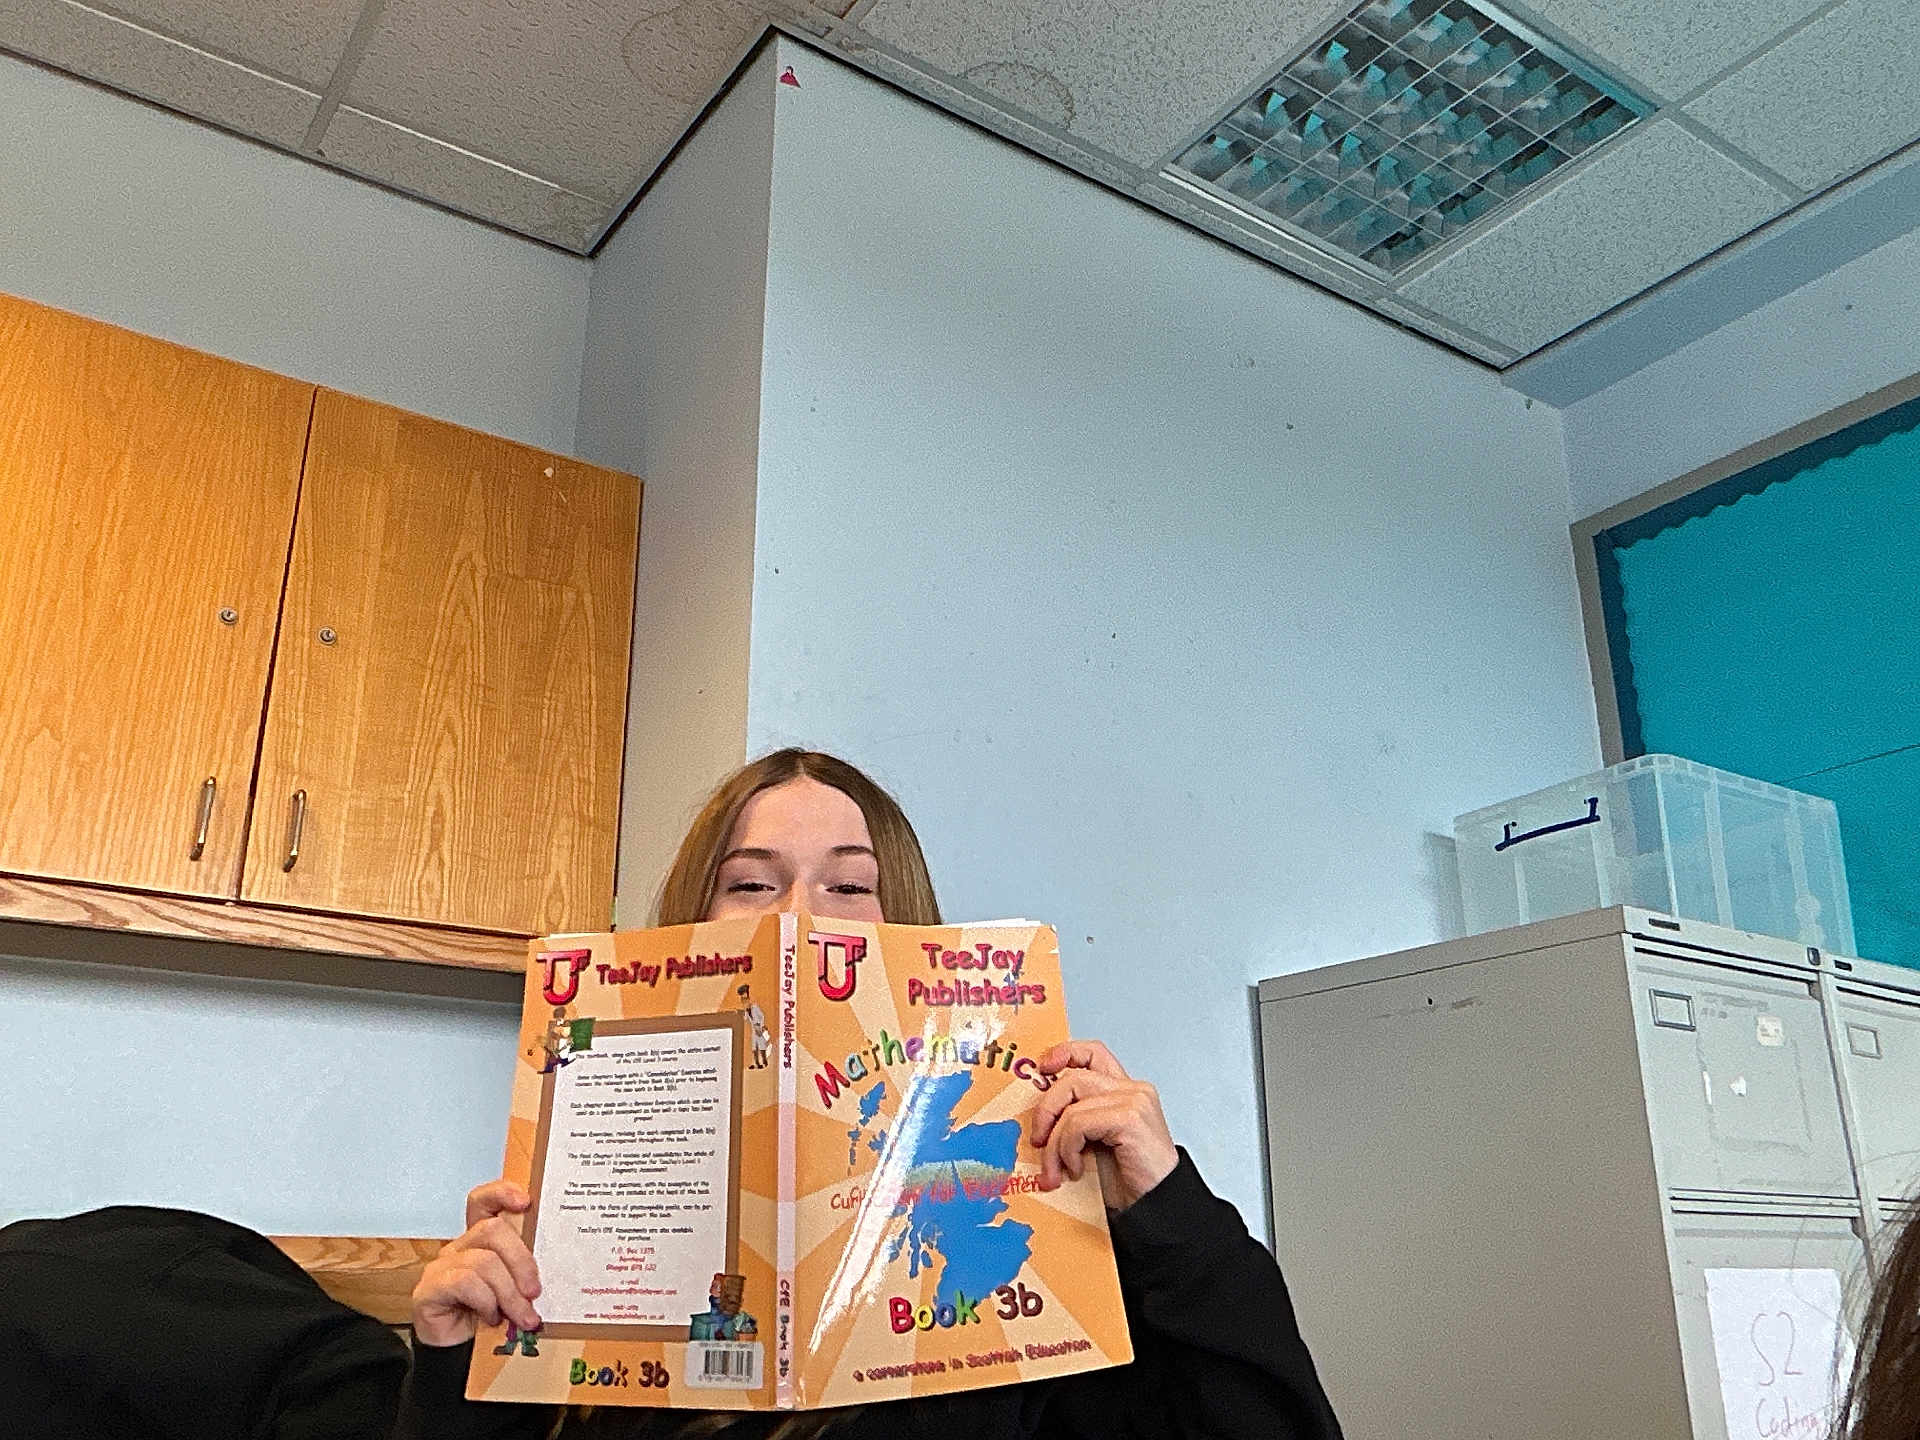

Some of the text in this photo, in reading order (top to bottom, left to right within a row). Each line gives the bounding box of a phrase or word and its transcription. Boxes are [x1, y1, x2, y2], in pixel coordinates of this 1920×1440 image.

[597, 953, 753, 988] TeeJay Publishers
[921, 943, 1024, 975] TeeJay
[782, 944, 795, 1069] TeeJay Publishers
[909, 978, 1046, 1006] Publishers
[815, 1029, 1057, 1109] Mathematics
[889, 1283, 1043, 1333] Book 3b
[966, 1348, 1023, 1368] Scottish
[1025, 1339, 1091, 1360] Education
[1751, 1311, 1803, 1386] S2
[569, 1358, 669, 1388] Book 3b
